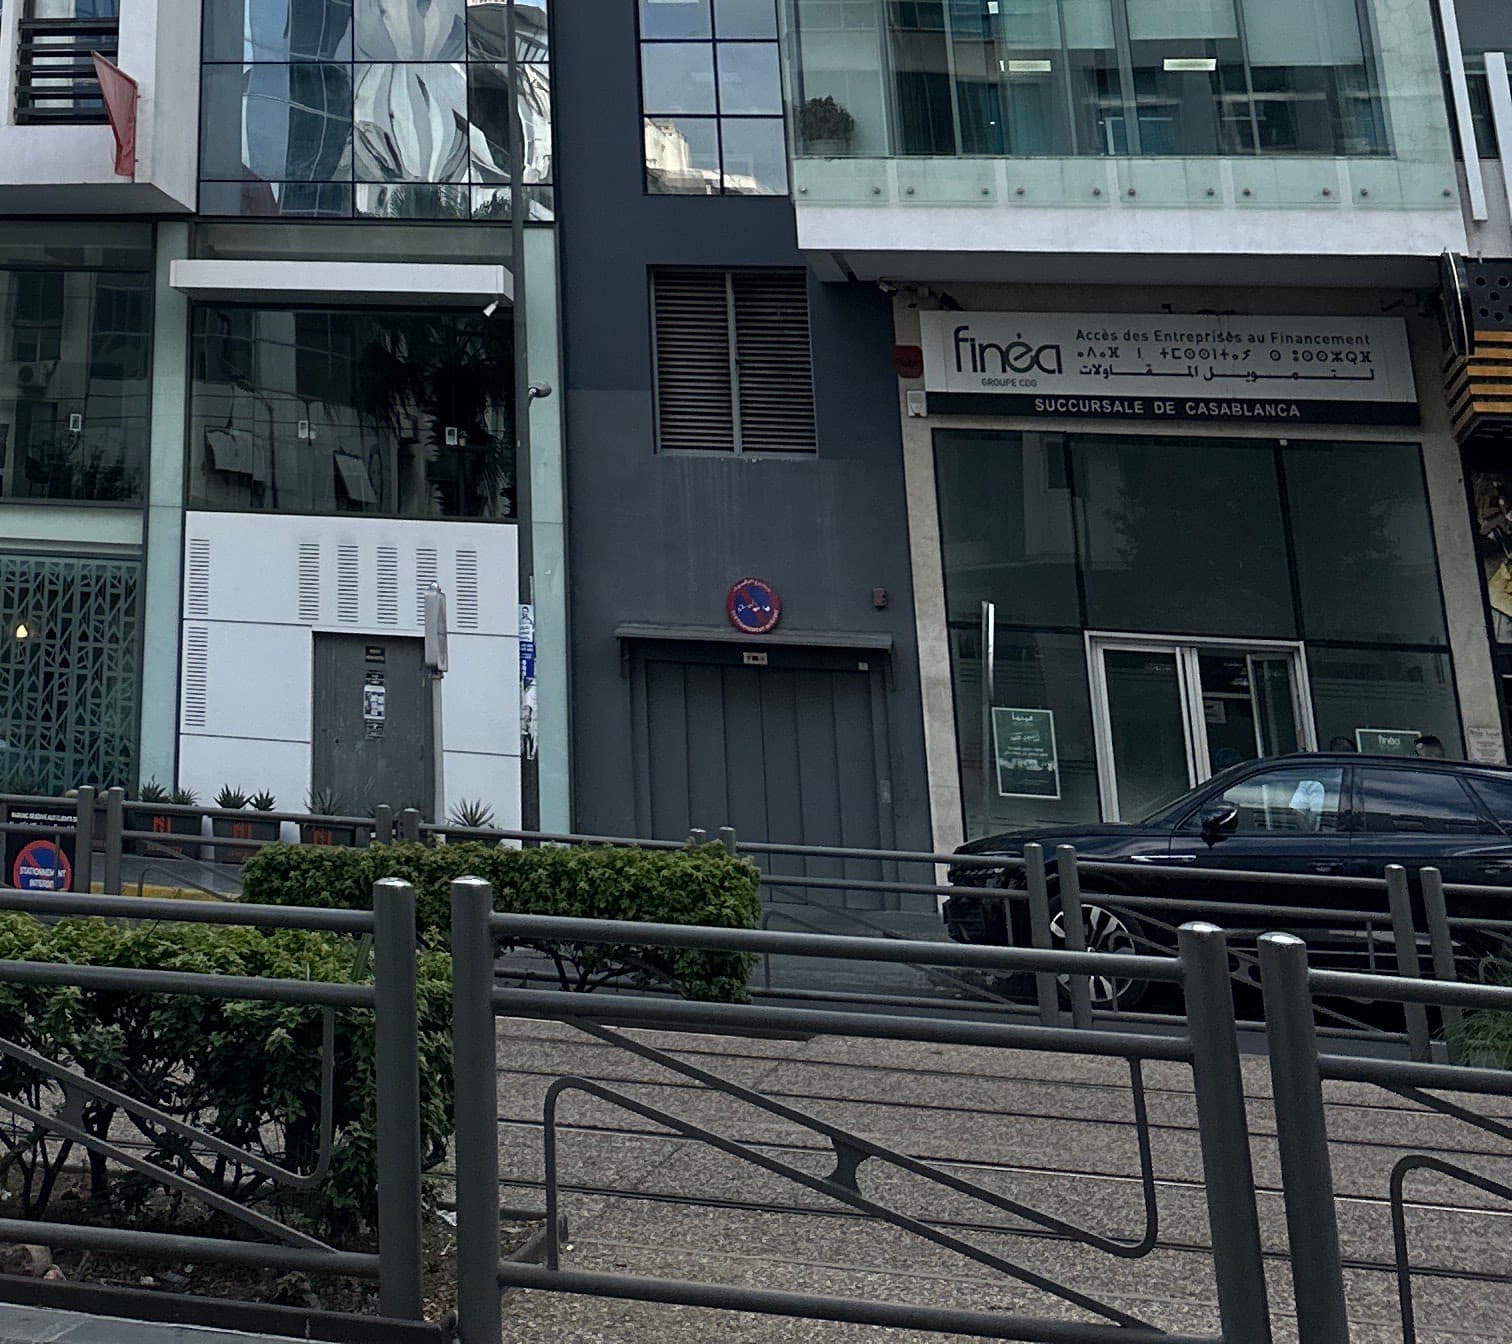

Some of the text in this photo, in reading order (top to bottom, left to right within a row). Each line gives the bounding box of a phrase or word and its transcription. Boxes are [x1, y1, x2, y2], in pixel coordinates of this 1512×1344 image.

[1076, 328, 1118, 342] Accès
[1123, 329, 1149, 342] des
[1247, 334, 1265, 344] au
[1271, 331, 1370, 346] Financement
[981, 377, 1038, 388] GROUPE CDG
[1034, 398, 1301, 418] SUCCURSALE DE CASABLANCA
